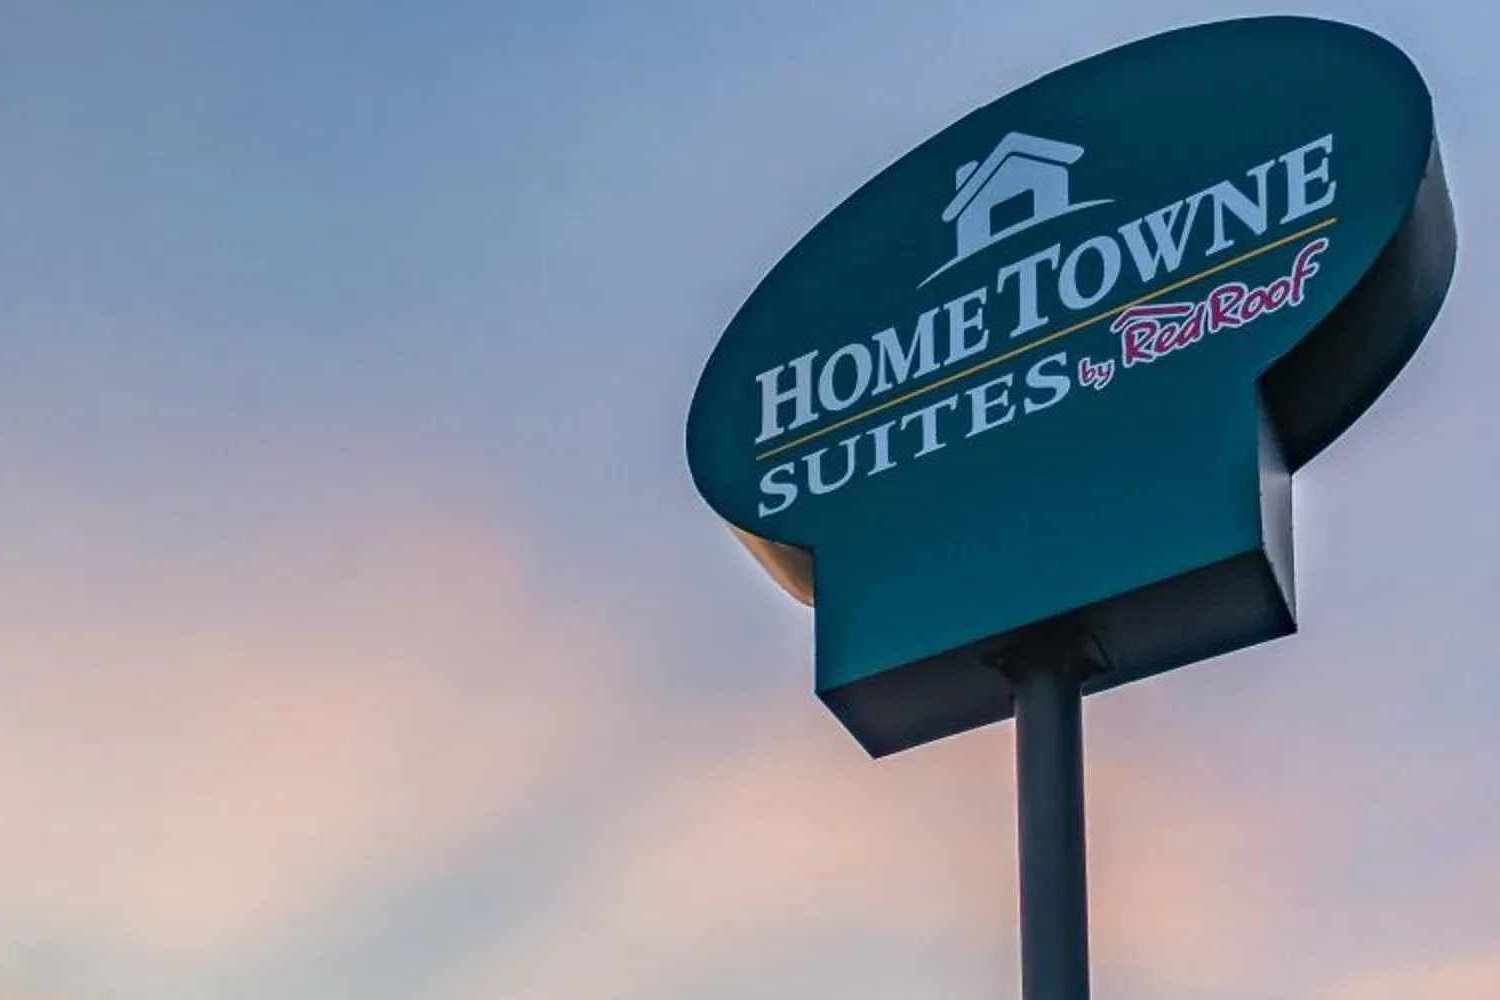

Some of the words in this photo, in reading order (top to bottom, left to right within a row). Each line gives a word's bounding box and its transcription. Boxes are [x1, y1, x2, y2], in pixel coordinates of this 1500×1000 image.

[755, 133, 1337, 443] HOMETOWNE
[757, 351, 1071, 519] SUITES
[1078, 357, 1115, 390] by
